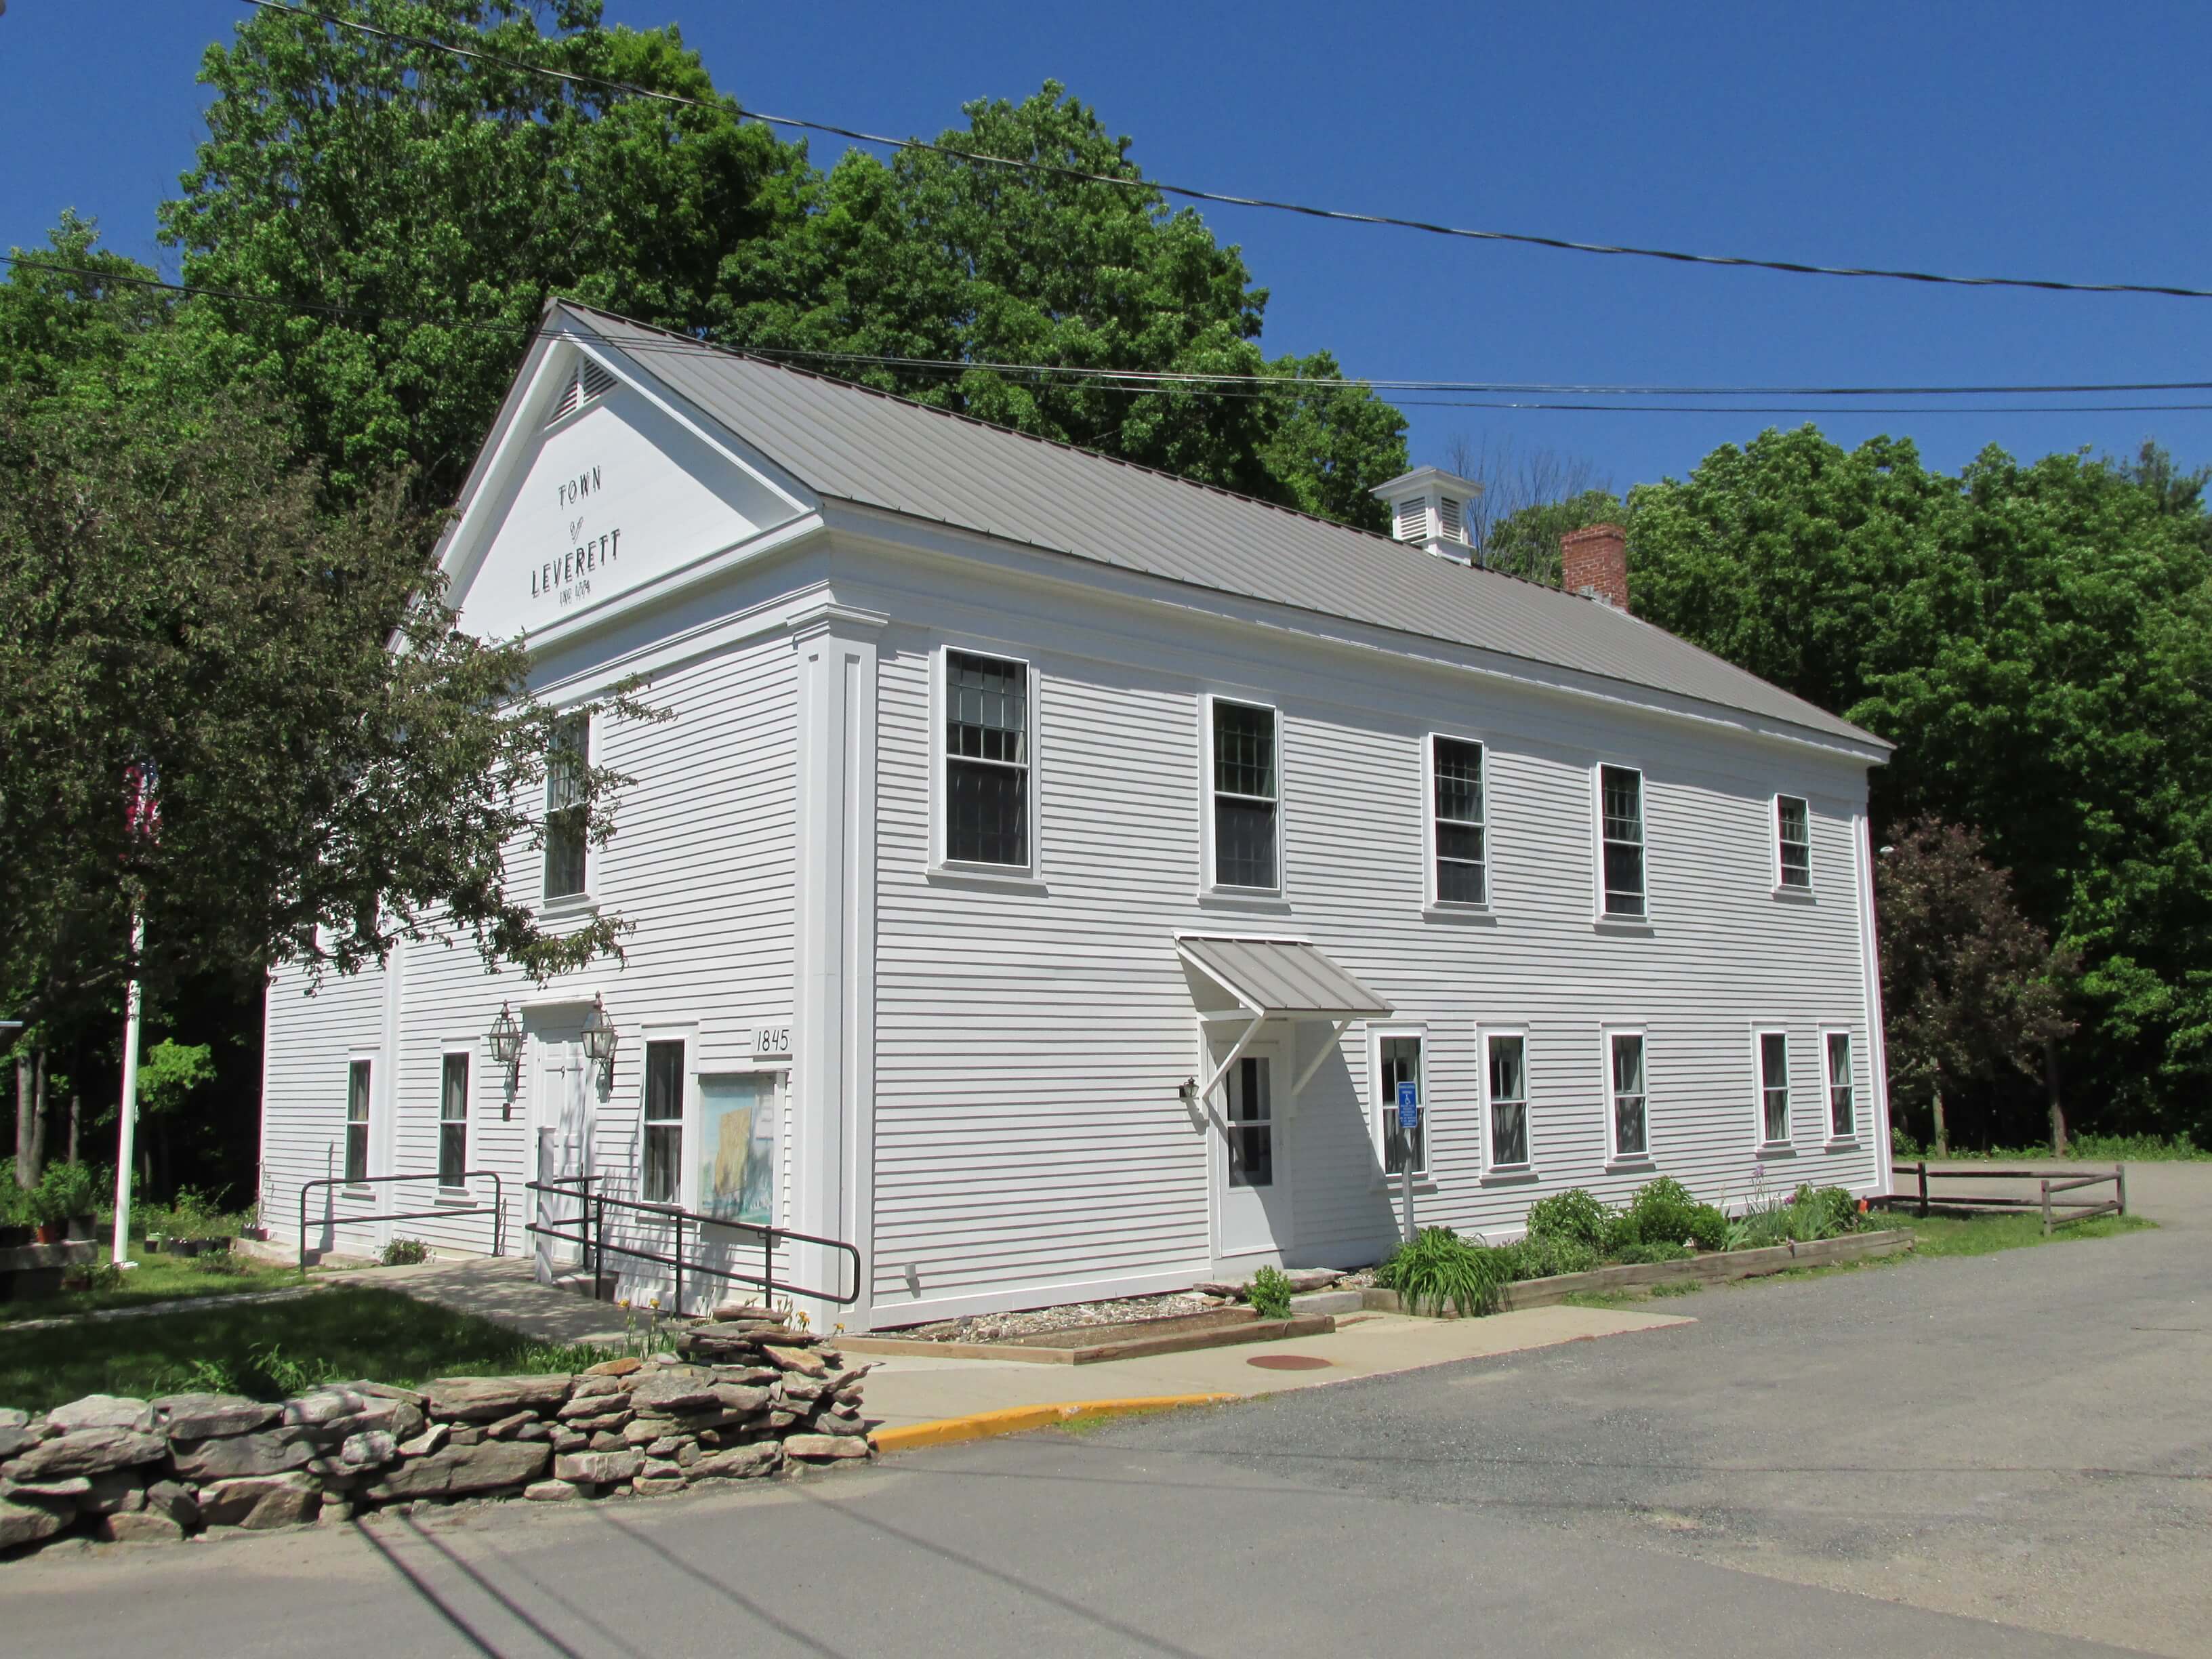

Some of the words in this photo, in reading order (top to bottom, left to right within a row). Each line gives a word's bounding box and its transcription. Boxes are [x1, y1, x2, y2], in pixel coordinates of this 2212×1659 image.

[558, 465, 601, 510] TOWN
[569, 516, 583, 544] of
[531, 528, 621, 598] LEVERETT
[756, 1029, 790, 1052] 1845
